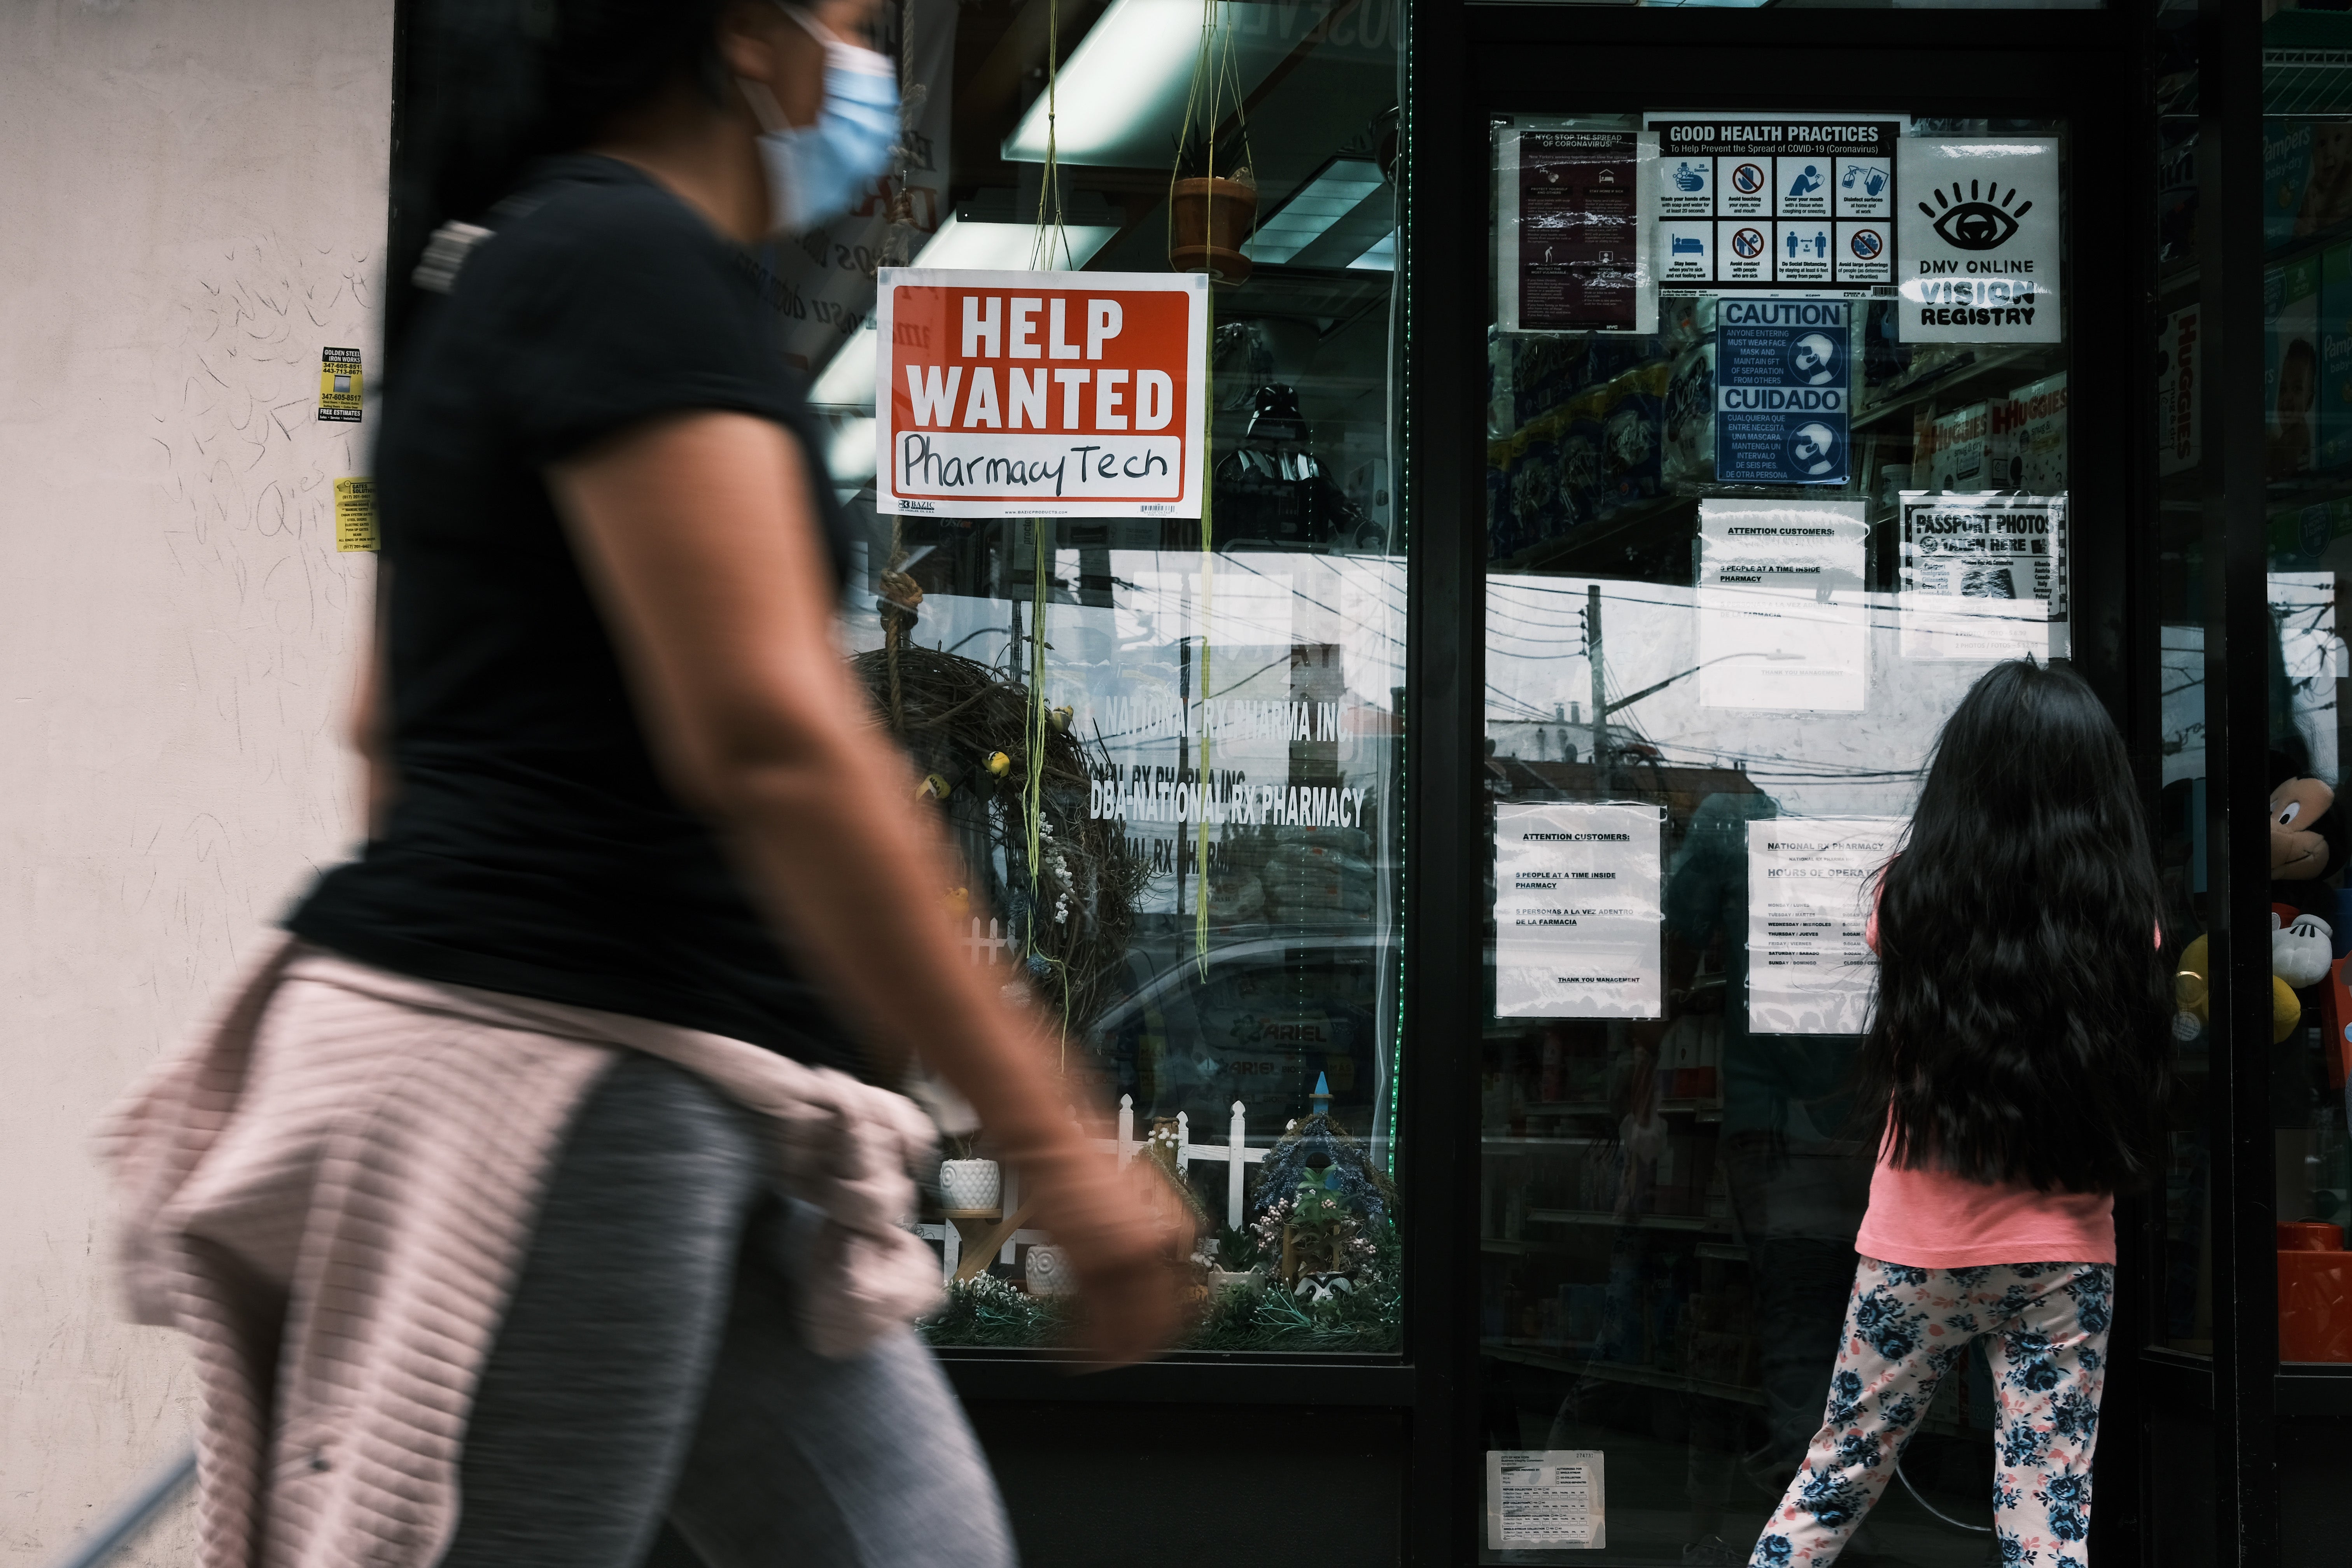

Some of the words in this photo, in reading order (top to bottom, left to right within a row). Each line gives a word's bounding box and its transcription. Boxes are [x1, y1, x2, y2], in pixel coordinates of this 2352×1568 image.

[1671, 126, 1715, 141] GOOD
[1721, 127, 1782, 141] HEALTH
[1788, 127, 1878, 142] PRACTICES
[1682, 145, 1698, 154] Help
[1748, 145, 1775, 154] Spread
[1827, 145, 1878, 154] (Coronavirus)
[1920, 260, 1958, 274] DMV
[1967, 260, 2033, 273] ONLINE
[1921, 281, 2035, 305] VISION
[1726, 304, 1840, 324] CAUTION
[1921, 308, 2035, 326] REGISTRY
[962, 296, 1123, 360] HELP
[906, 365, 1173, 430] WANTED
[1725, 389, 1840, 410] CUIDADO
[2009, 387, 2067, 427] HUGGIES
[1071, 446, 1168, 483] Tech
[1916, 514, 1992, 534] PASSPORT
[1997, 514, 2054, 534] PHOTOS
[1990, 539, 2026, 551] HERE
[1106, 696, 1196, 737] NATIONAL
[1203, 698, 1225, 738] RX
[1234, 700, 1310, 741] PHARMA
[1317, 702, 1354, 742] INC.
[1090, 780, 1225, 823] DBA-NATIONAL
[1231, 784, 1255, 824] RX
[1262, 786, 1365, 828] PHARMACY
[1263, 1023, 1326, 1043] ARIEL
[1227, 1061, 1282, 1075] ARIEL
